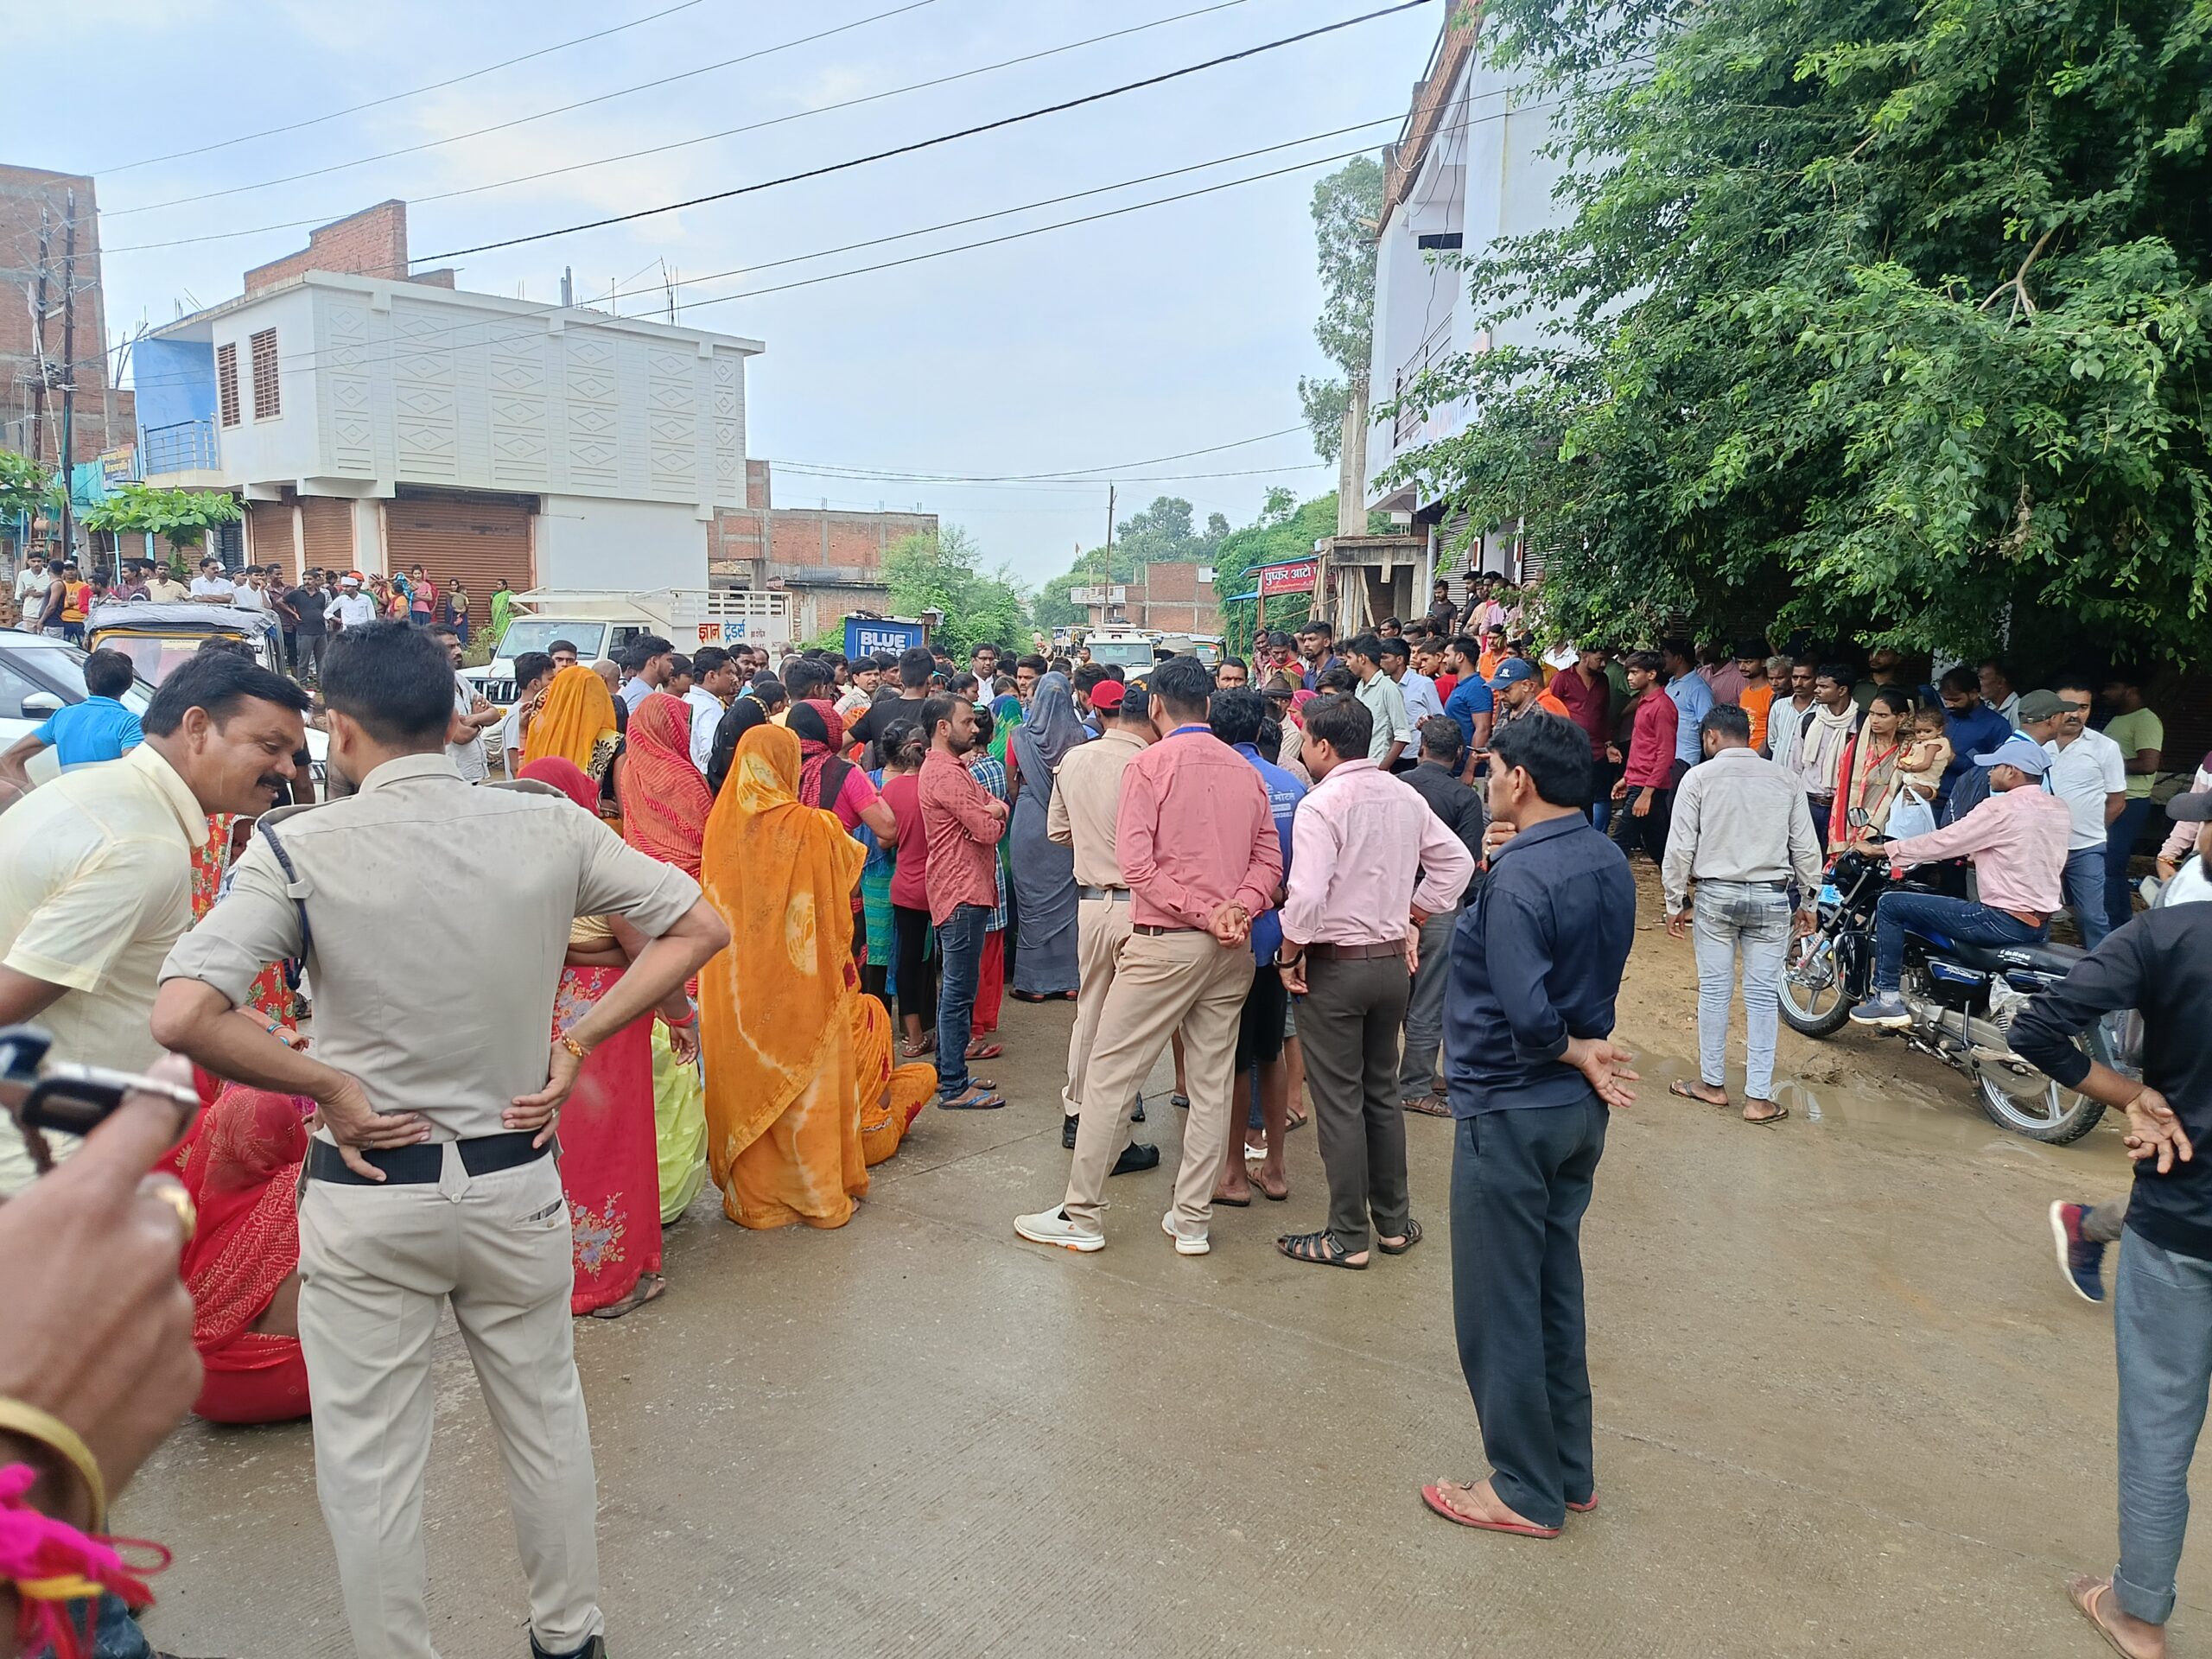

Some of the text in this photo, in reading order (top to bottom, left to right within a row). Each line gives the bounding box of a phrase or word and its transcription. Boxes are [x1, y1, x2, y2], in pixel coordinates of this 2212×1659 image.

[1265, 569, 1289, 586] पुष्कर
[1291, 563, 1312, 579] आटो
[698, 623, 721, 643] ज्ञान
[724, 619, 746, 643] ट्रेडर्स
[861, 631, 906, 648] BLUE
